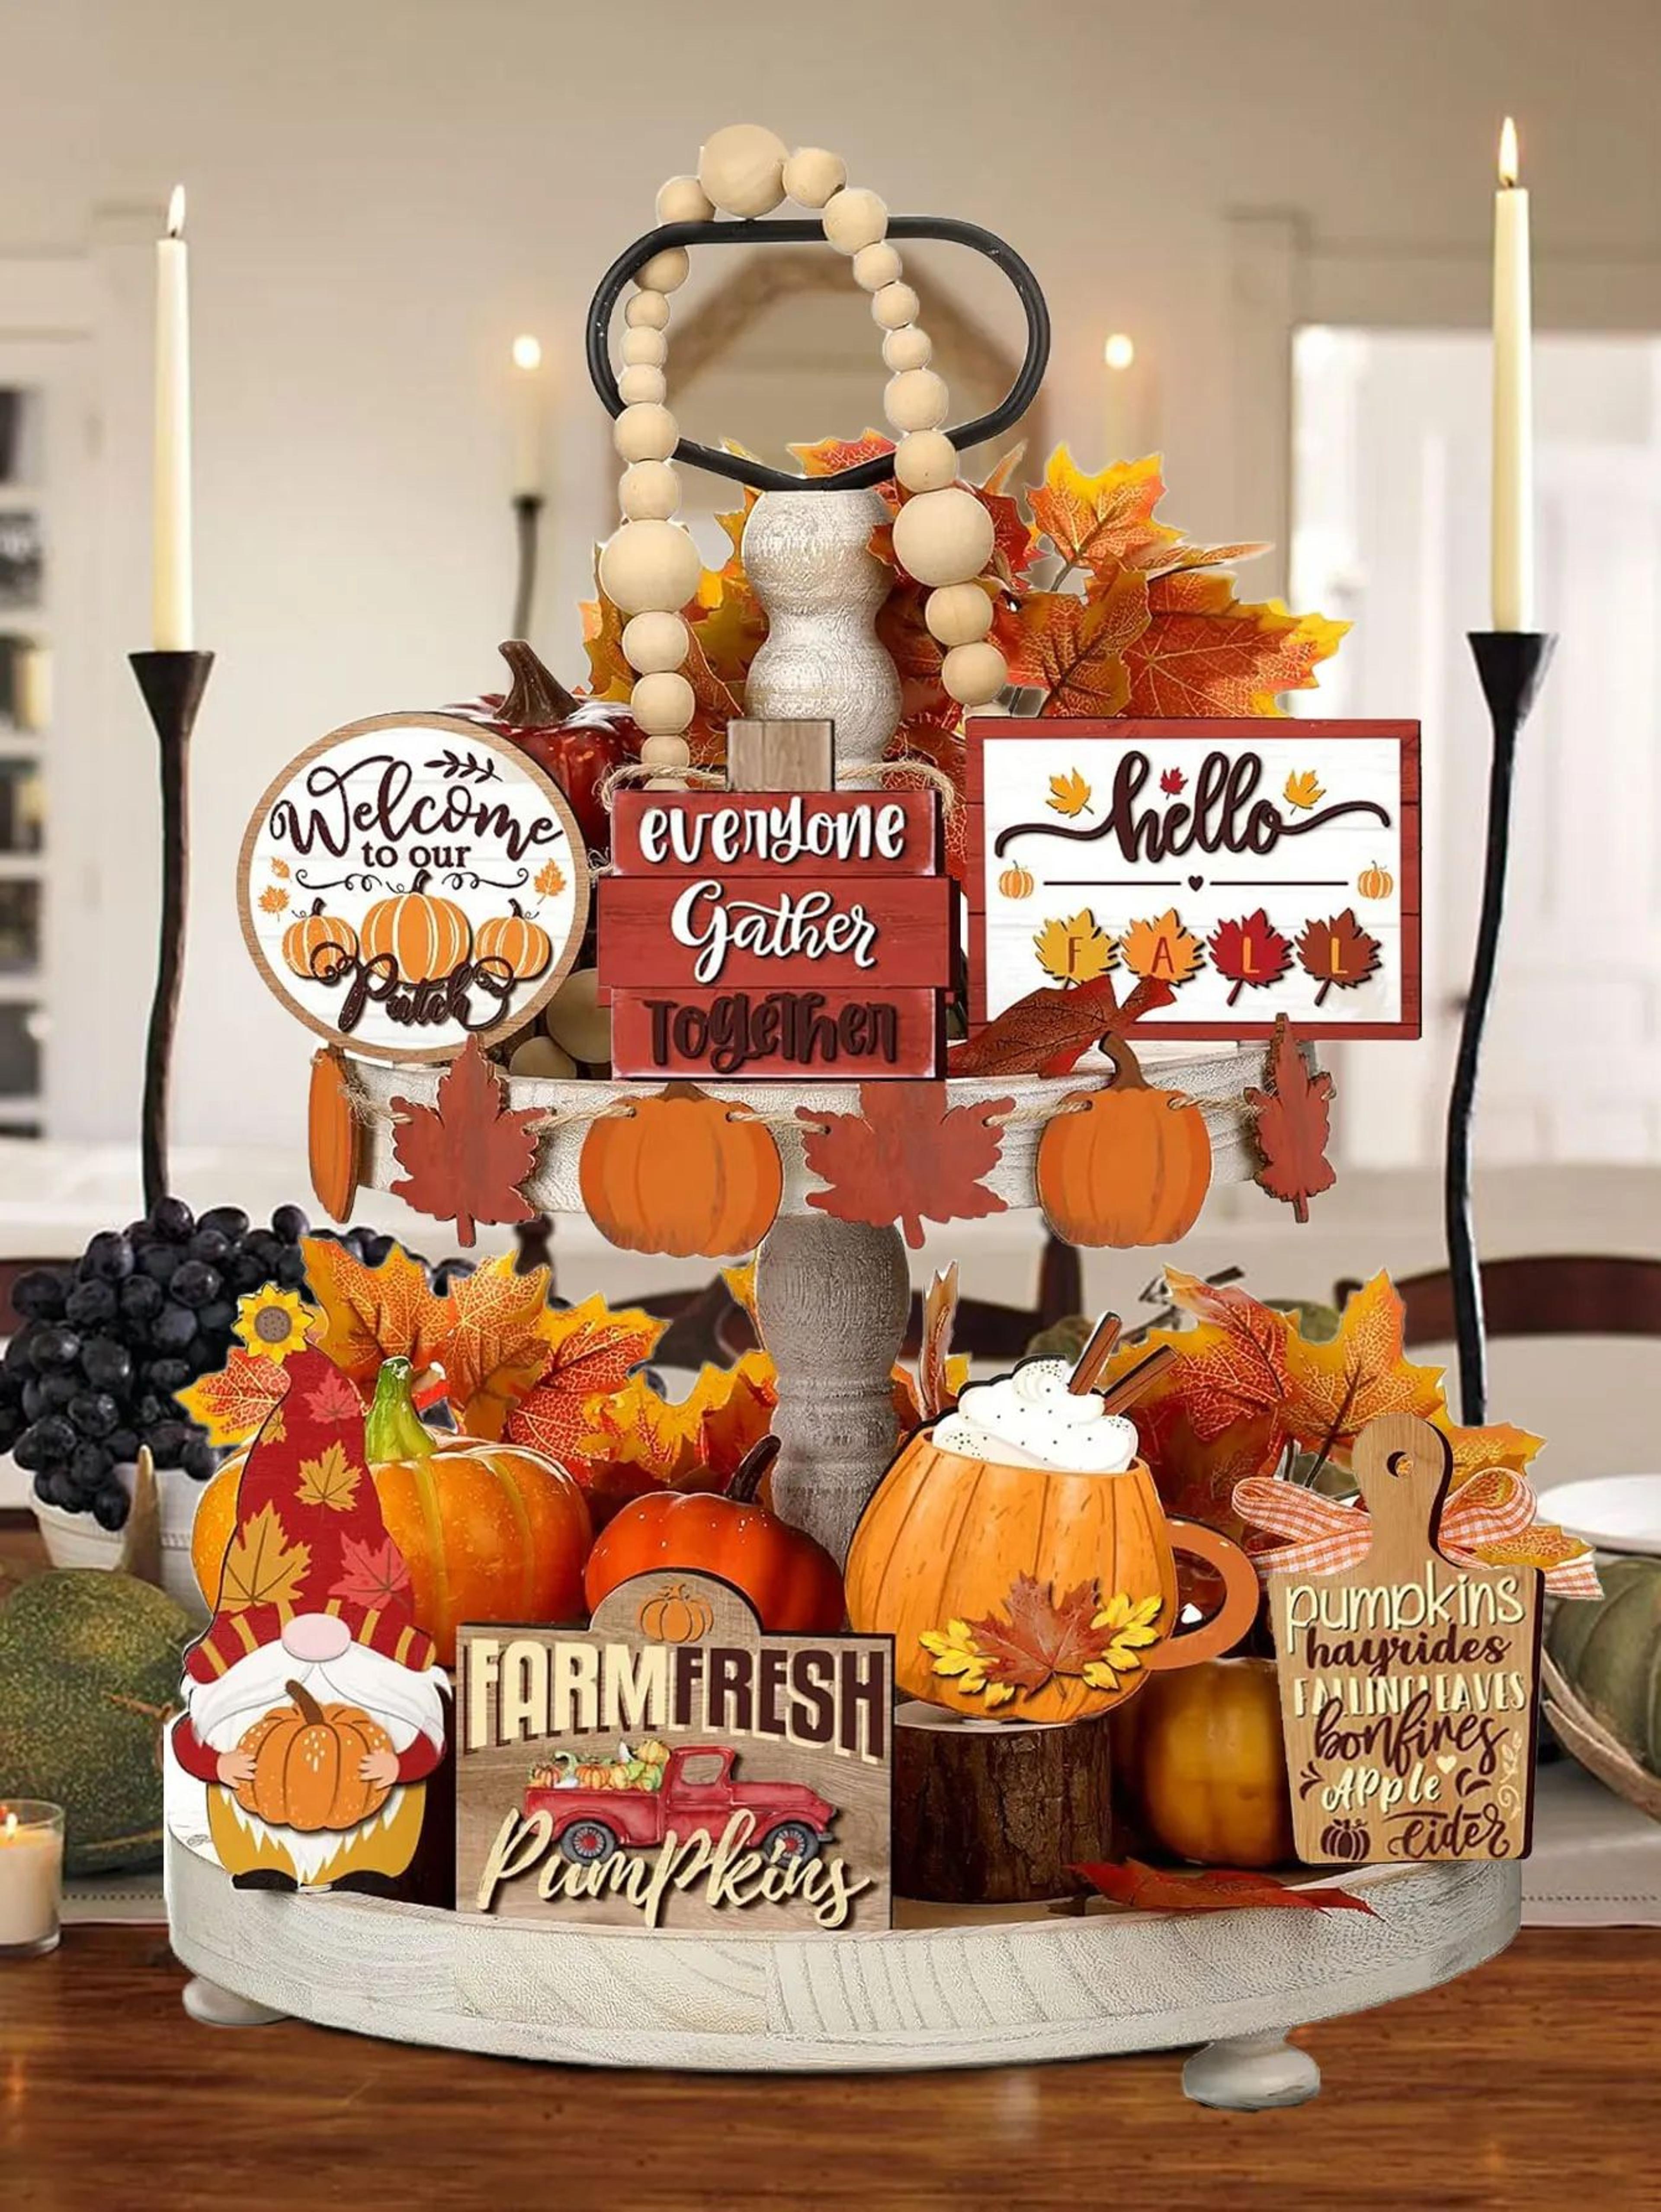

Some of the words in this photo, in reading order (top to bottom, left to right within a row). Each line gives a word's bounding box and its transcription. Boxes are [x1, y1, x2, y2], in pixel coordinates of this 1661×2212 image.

[269, 755, 564, 861] Welcome
[639, 795, 906, 864] everyone
[362, 841, 398, 868] to
[408, 845, 471, 868] our
[670, 879, 878, 984] Gather
[310, 941, 514, 1032] Patch
[1285, 1560, 1526, 1655] pumpkins
[1306, 1623, 1512, 1677] hayrides
[1314, 1690, 1510, 1777] bonfires
[475, 1807, 871, 1928] Pumpkins
